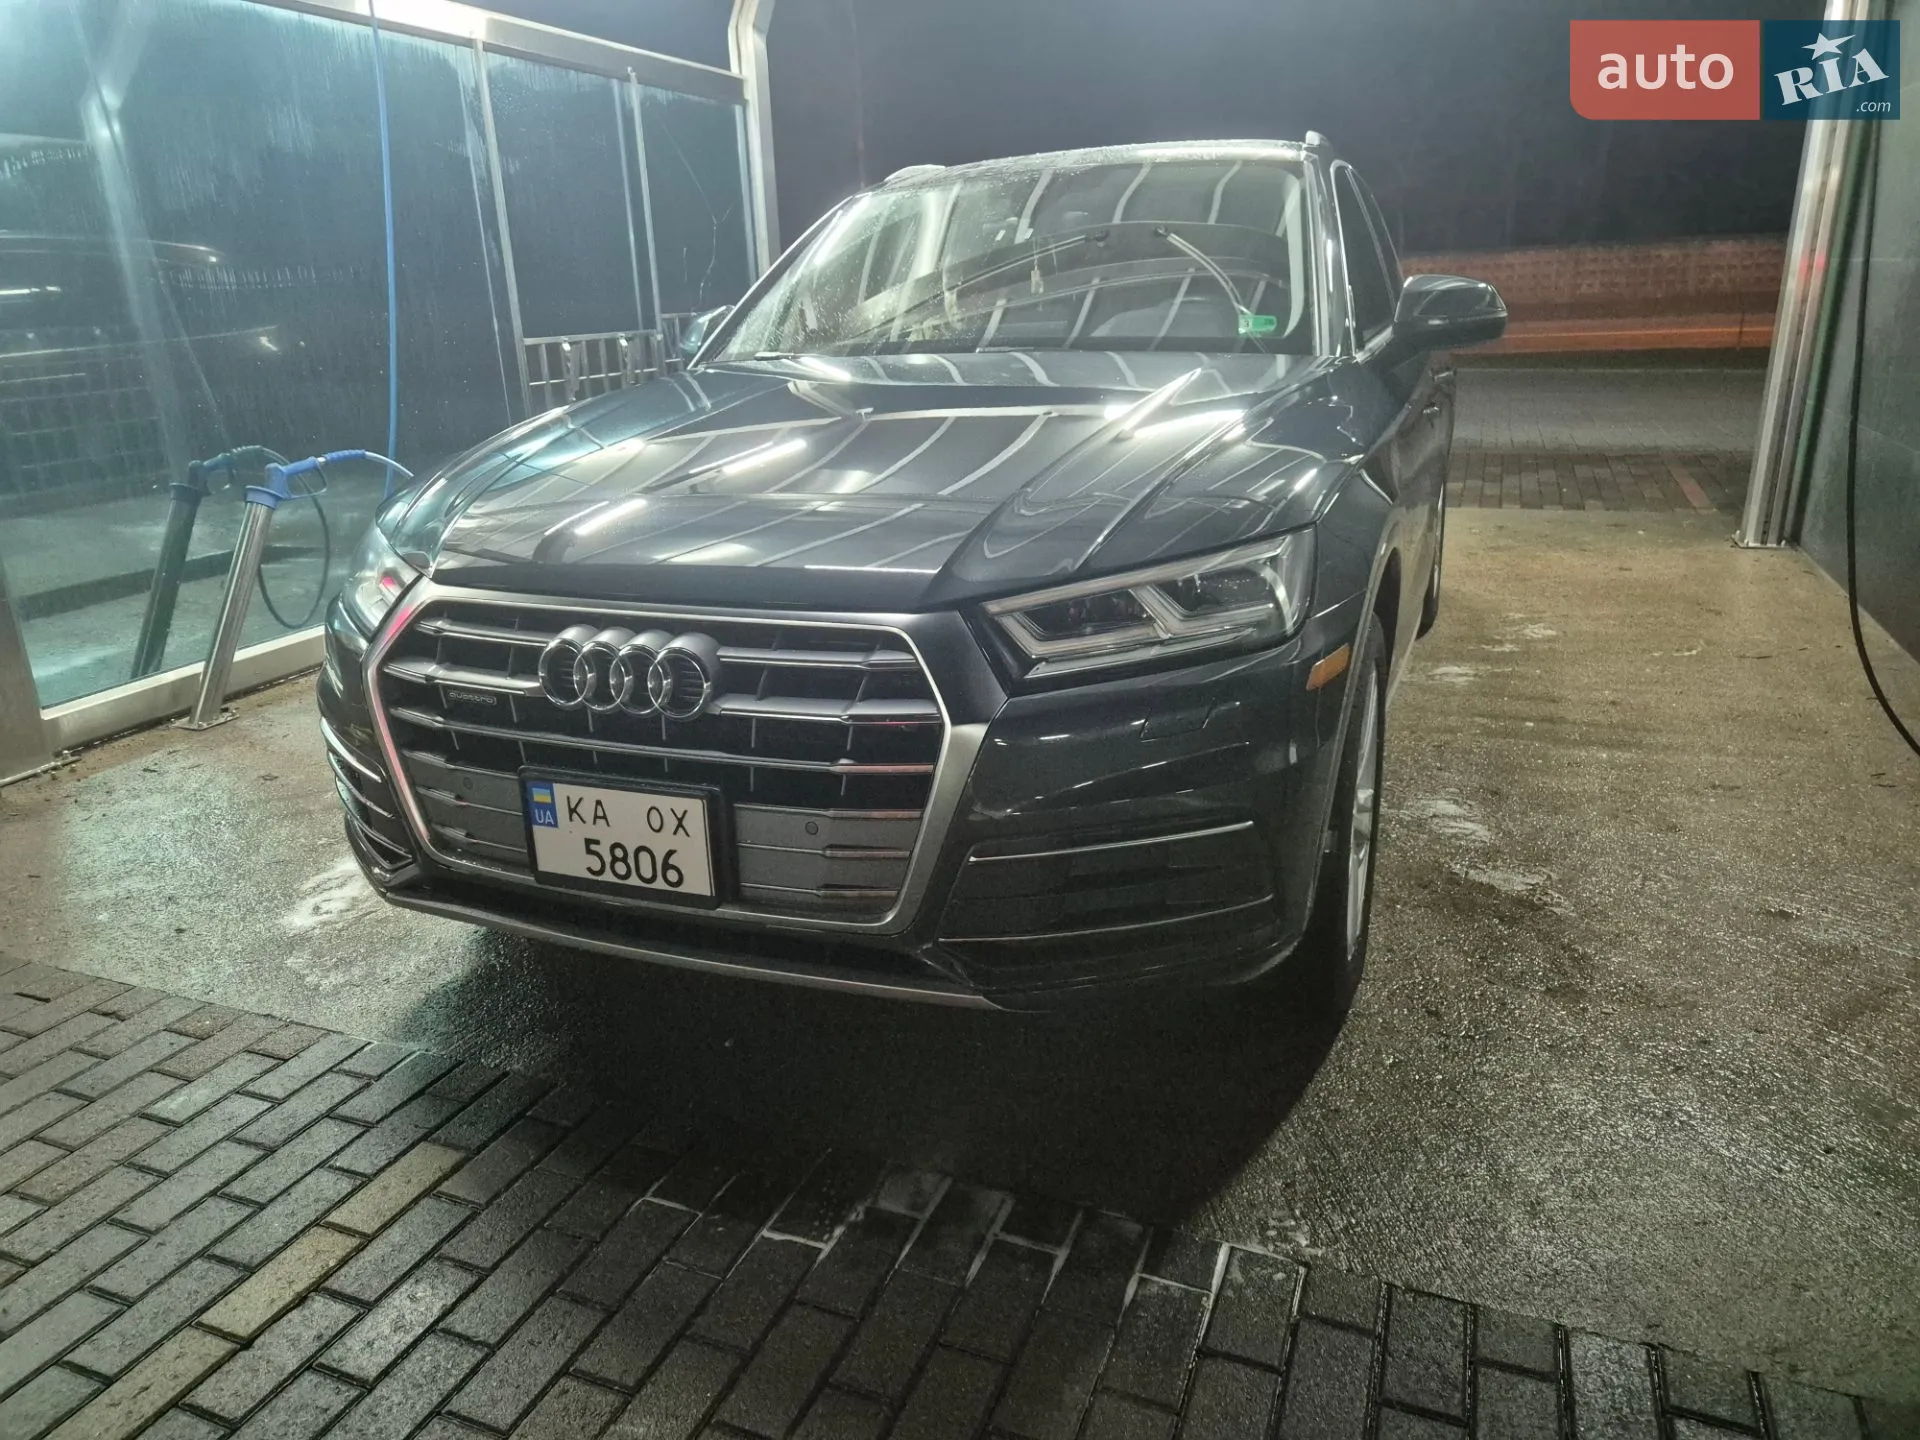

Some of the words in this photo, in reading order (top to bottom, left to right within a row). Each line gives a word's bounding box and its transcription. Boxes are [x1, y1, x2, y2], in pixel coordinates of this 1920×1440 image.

[535, 809, 555, 825] UA
[566, 795, 611, 828] KA
[646, 806, 690, 837] OX
[584, 837, 684, 888] 5806
